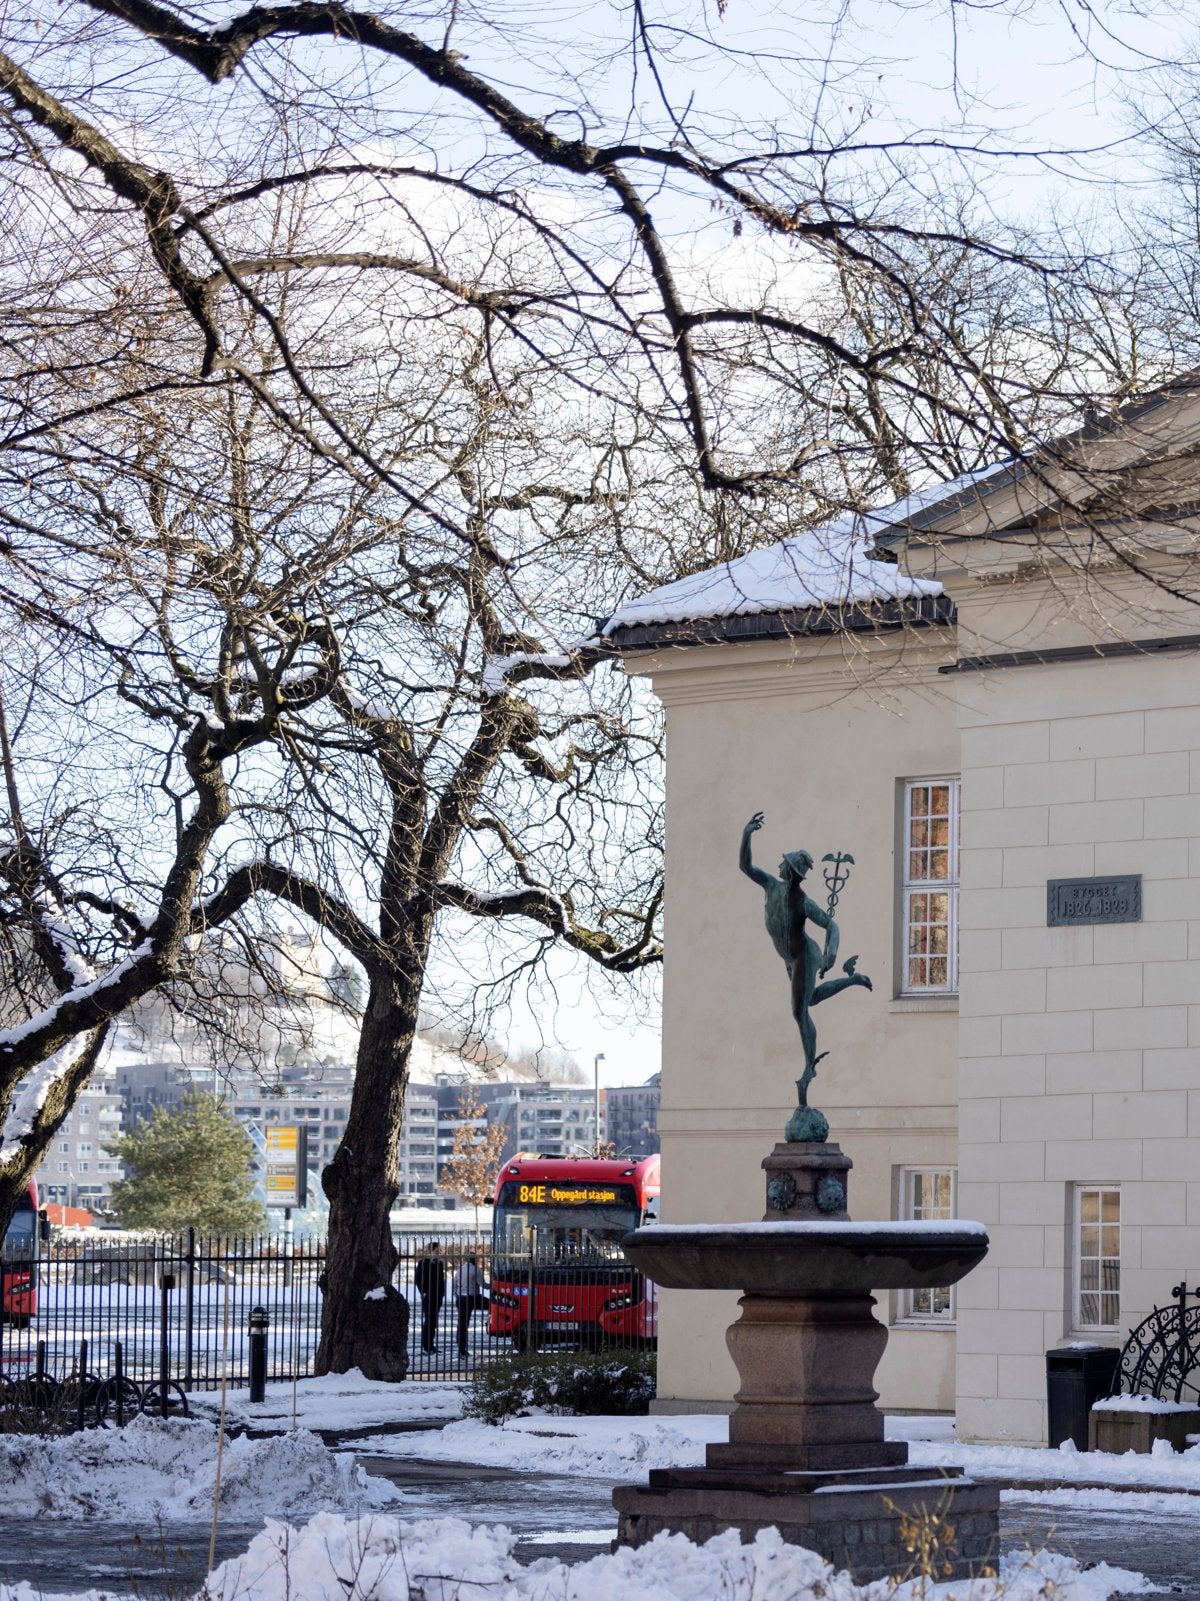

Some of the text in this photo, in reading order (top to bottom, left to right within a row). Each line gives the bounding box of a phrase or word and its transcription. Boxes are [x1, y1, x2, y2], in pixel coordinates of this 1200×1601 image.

[519, 1185, 616, 1203] 84E Oppegård stasjon
